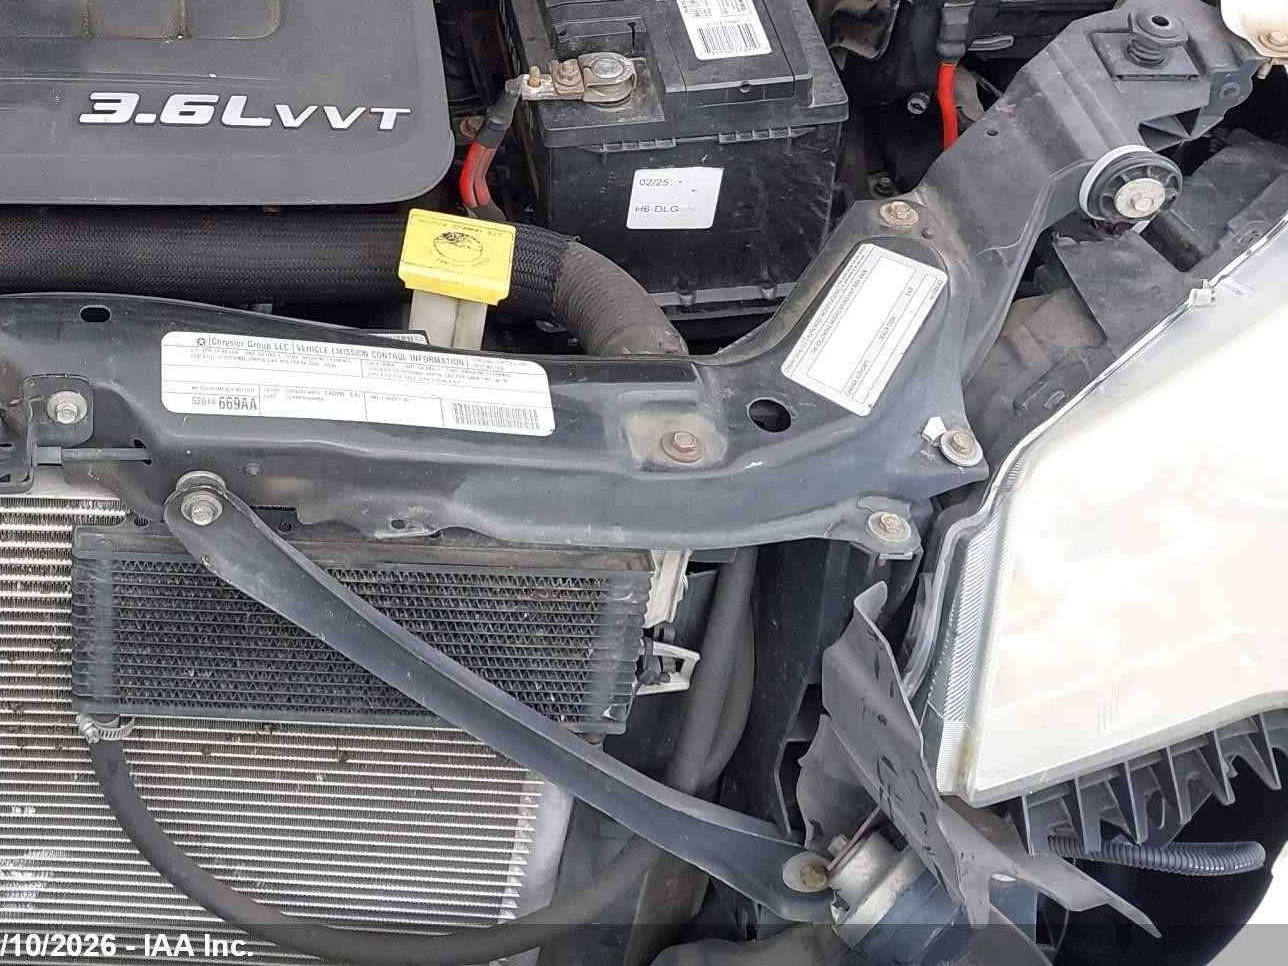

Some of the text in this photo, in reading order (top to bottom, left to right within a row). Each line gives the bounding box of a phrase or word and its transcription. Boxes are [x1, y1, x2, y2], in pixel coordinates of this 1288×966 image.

[212, 338, 289, 351] Chrysler Group LLC
[296, 344, 329, 354] VEHICLE
[331, 347, 369, 357] EMISSION
[372, 351, 407, 362] CONTROL
[410, 354, 464, 366] INFORMATION
[219, 397, 257, 410] 669AA
